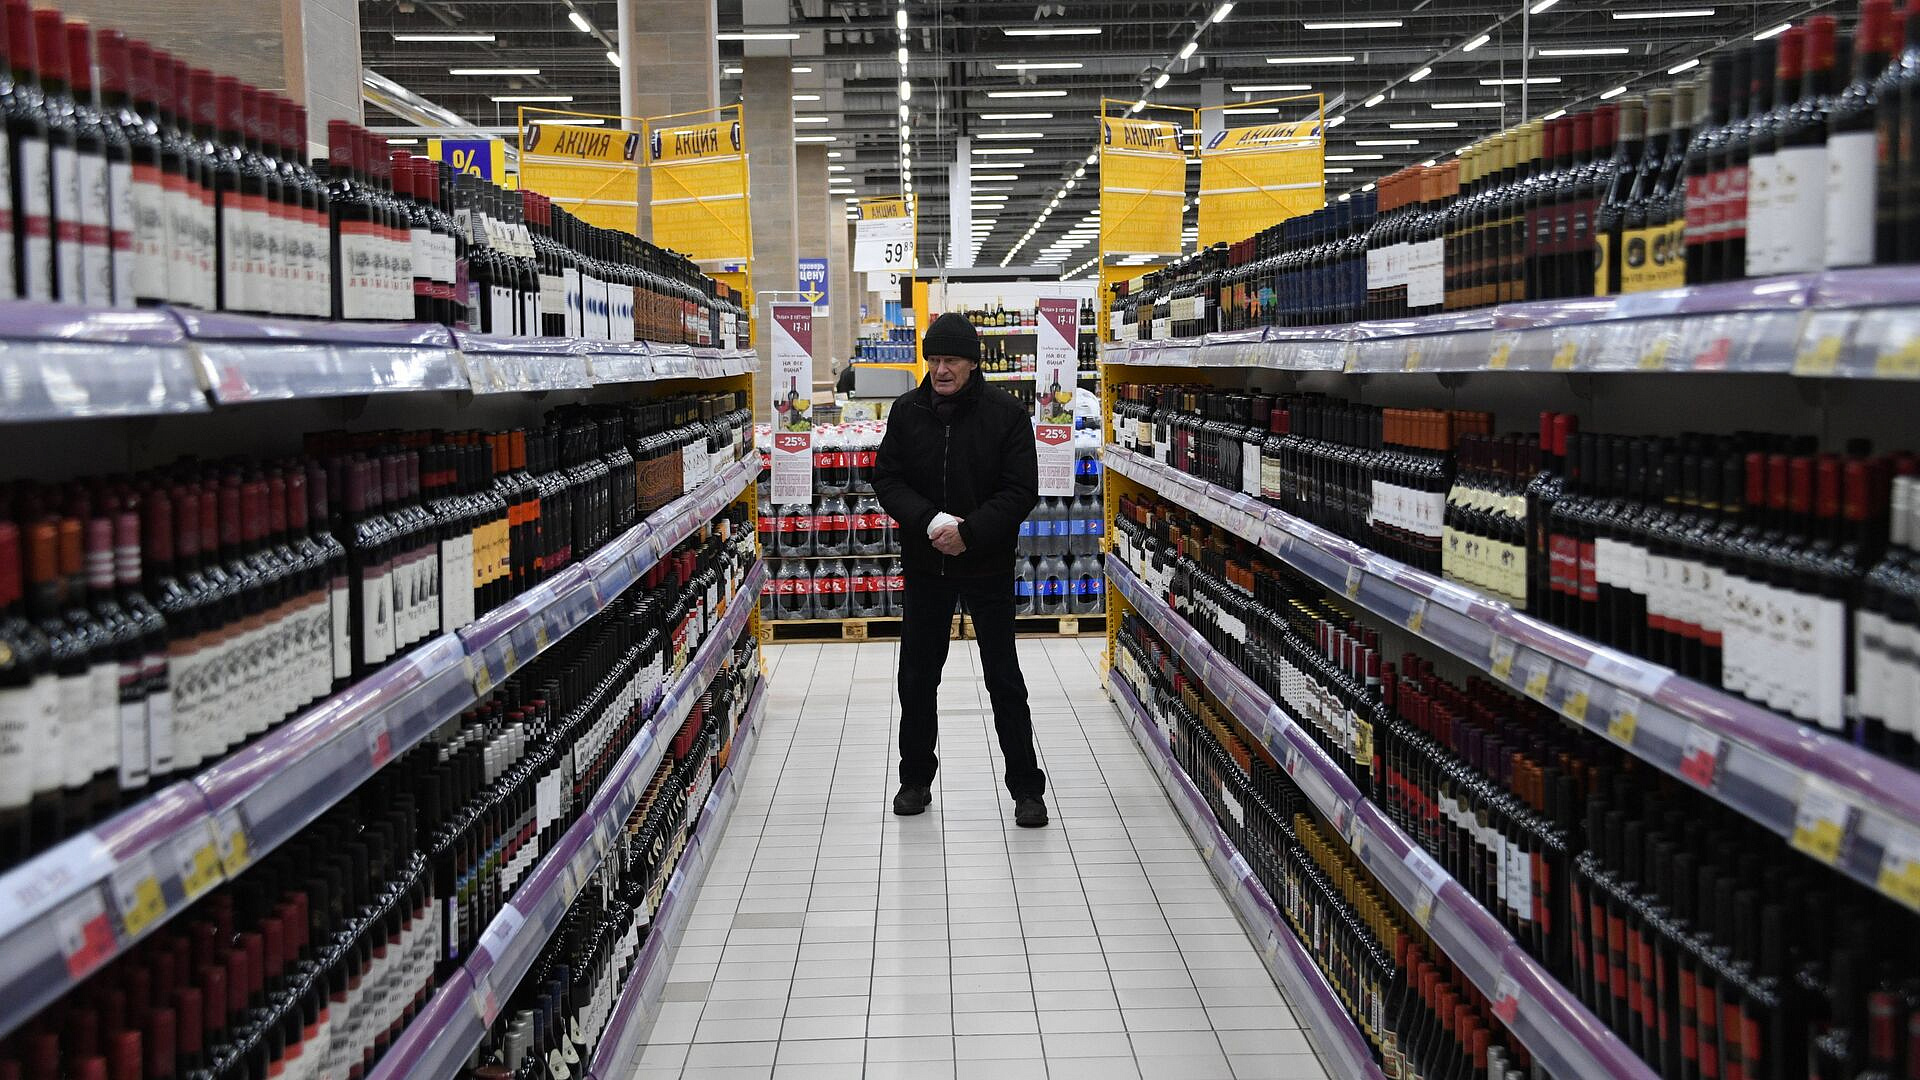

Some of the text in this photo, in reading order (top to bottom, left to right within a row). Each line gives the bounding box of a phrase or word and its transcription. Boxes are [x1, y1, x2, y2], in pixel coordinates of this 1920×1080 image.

[1124, 122, 1164, 149] АКЦИЯ
[553, 130, 611, 159] АКЦИЯ
[675, 128, 718, 157] АКЦИЯ
[871, 203, 898, 219] АКЦИЯ
[884, 243, 903, 263] 59
[799, 263, 825, 272] проверь
[799, 270, 825, 283] цену
[1057, 315, 1075, 326] 17.11
[793, 322, 810, 333] 17.11
[1039, 429, 1068, 440] -25%
[778, 436, 808, 447] -25%
